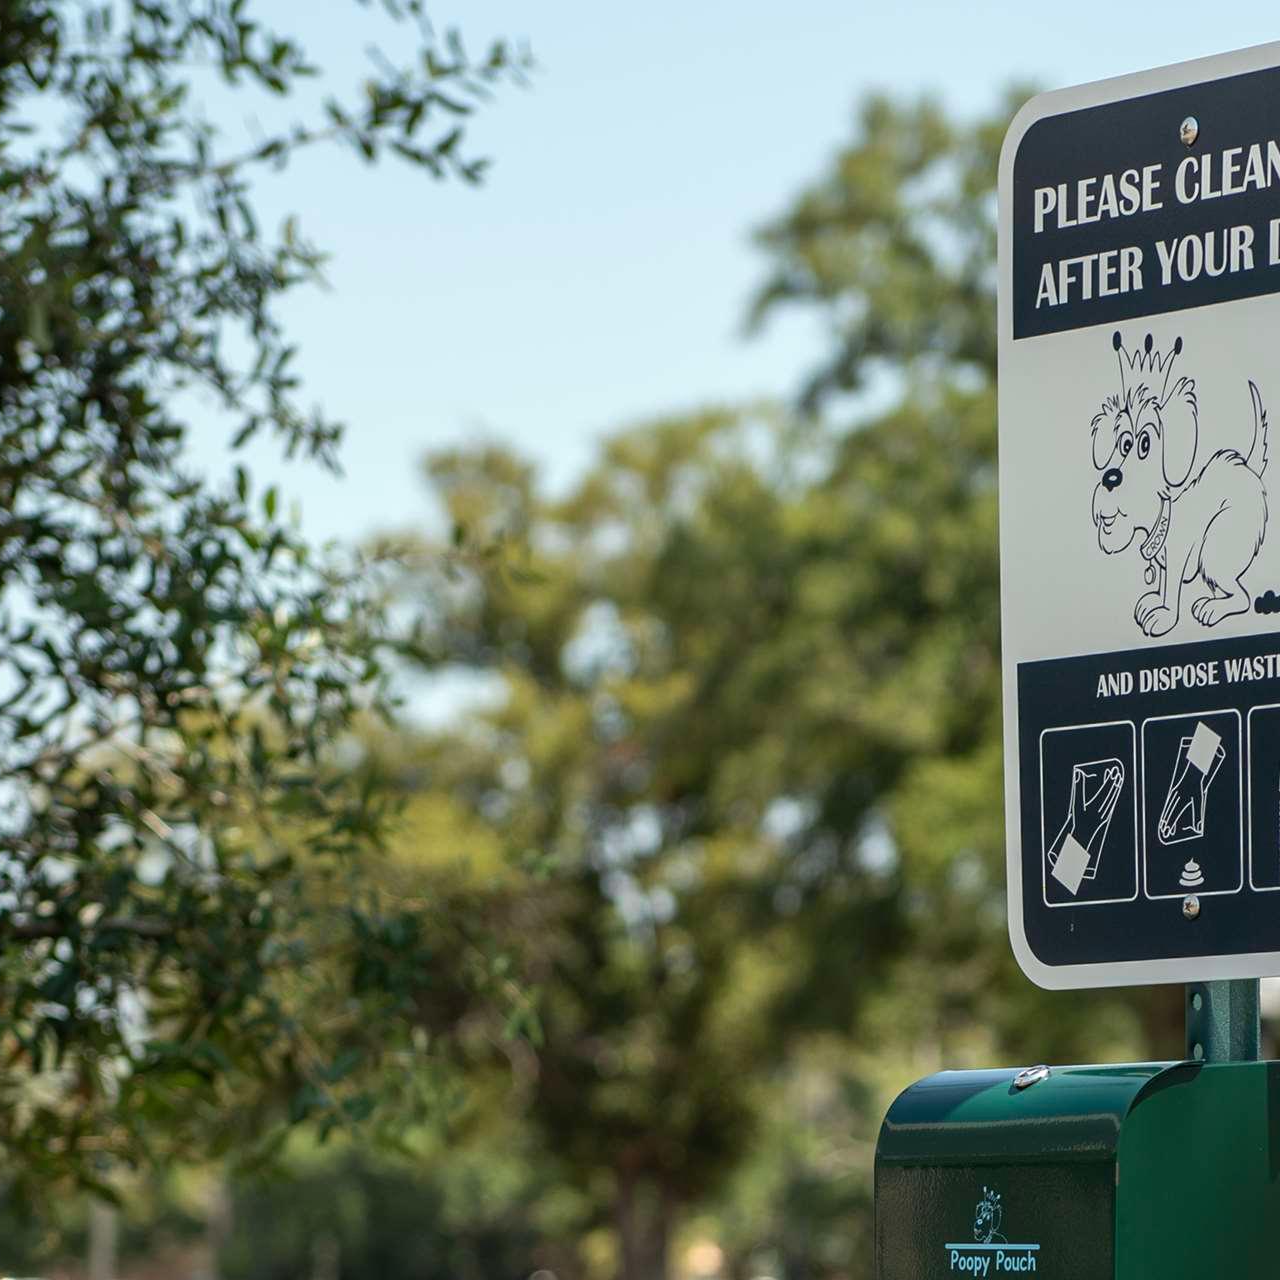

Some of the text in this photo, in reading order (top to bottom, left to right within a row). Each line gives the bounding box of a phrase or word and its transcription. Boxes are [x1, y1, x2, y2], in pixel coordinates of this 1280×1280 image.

[1034, 164, 1163, 233] PLEASE
[1036, 246, 1143, 309] AFTER
[1155, 224, 1255, 286] YOUR
[1146, 516, 1168, 557] CROWN
[1096, 672, 1134, 698] AND
[1139, 662, 1219, 692] DISPOSE
[950, 1250, 1036, 1277] Poopy Pouch
